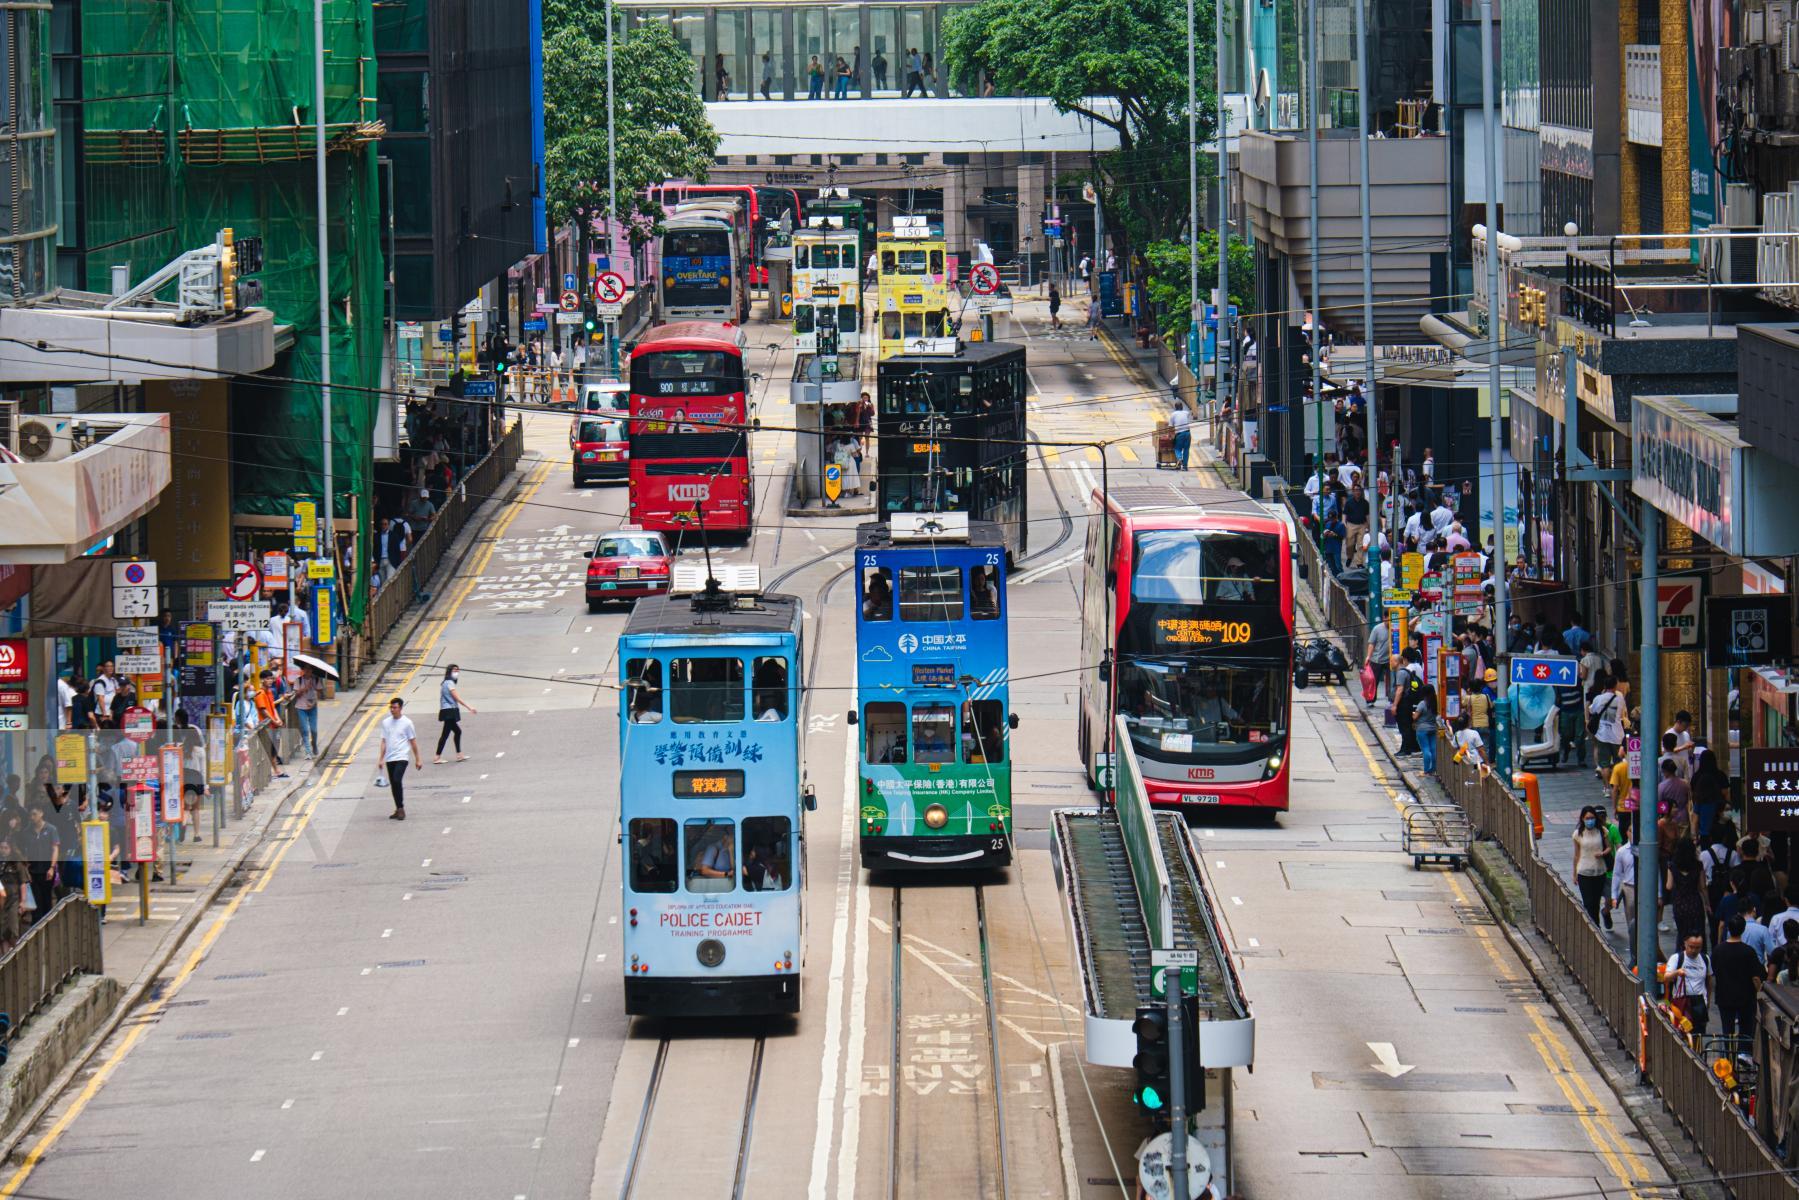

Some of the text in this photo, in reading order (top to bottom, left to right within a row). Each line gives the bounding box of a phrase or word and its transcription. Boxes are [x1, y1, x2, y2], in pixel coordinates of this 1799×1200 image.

[904, 228, 920, 236] 150
[660, 383, 673, 393] 900
[668, 484, 709, 501] KMB
[496, 534, 600, 544] PEDDE
[493, 542, 596, 552] STREE
[864, 554, 999, 566] 25 25
[476, 573, 588, 582] CHATE
[478, 581, 585, 590] ROAD
[142, 590, 149, 599] 7
[142, 604, 149, 614] 7
[228, 620, 239, 628] 12
[259, 620, 269, 628] 12
[1221, 623, 1250, 643] 109
[922, 634, 966, 644] 中国太平
[1188, 768, 1214, 779] KMB
[877, 778, 995, 789] 中國太平保險(香港)有限公司
[992, 839, 1003, 850] 25
[660, 911, 762, 927] POLICE CADET
